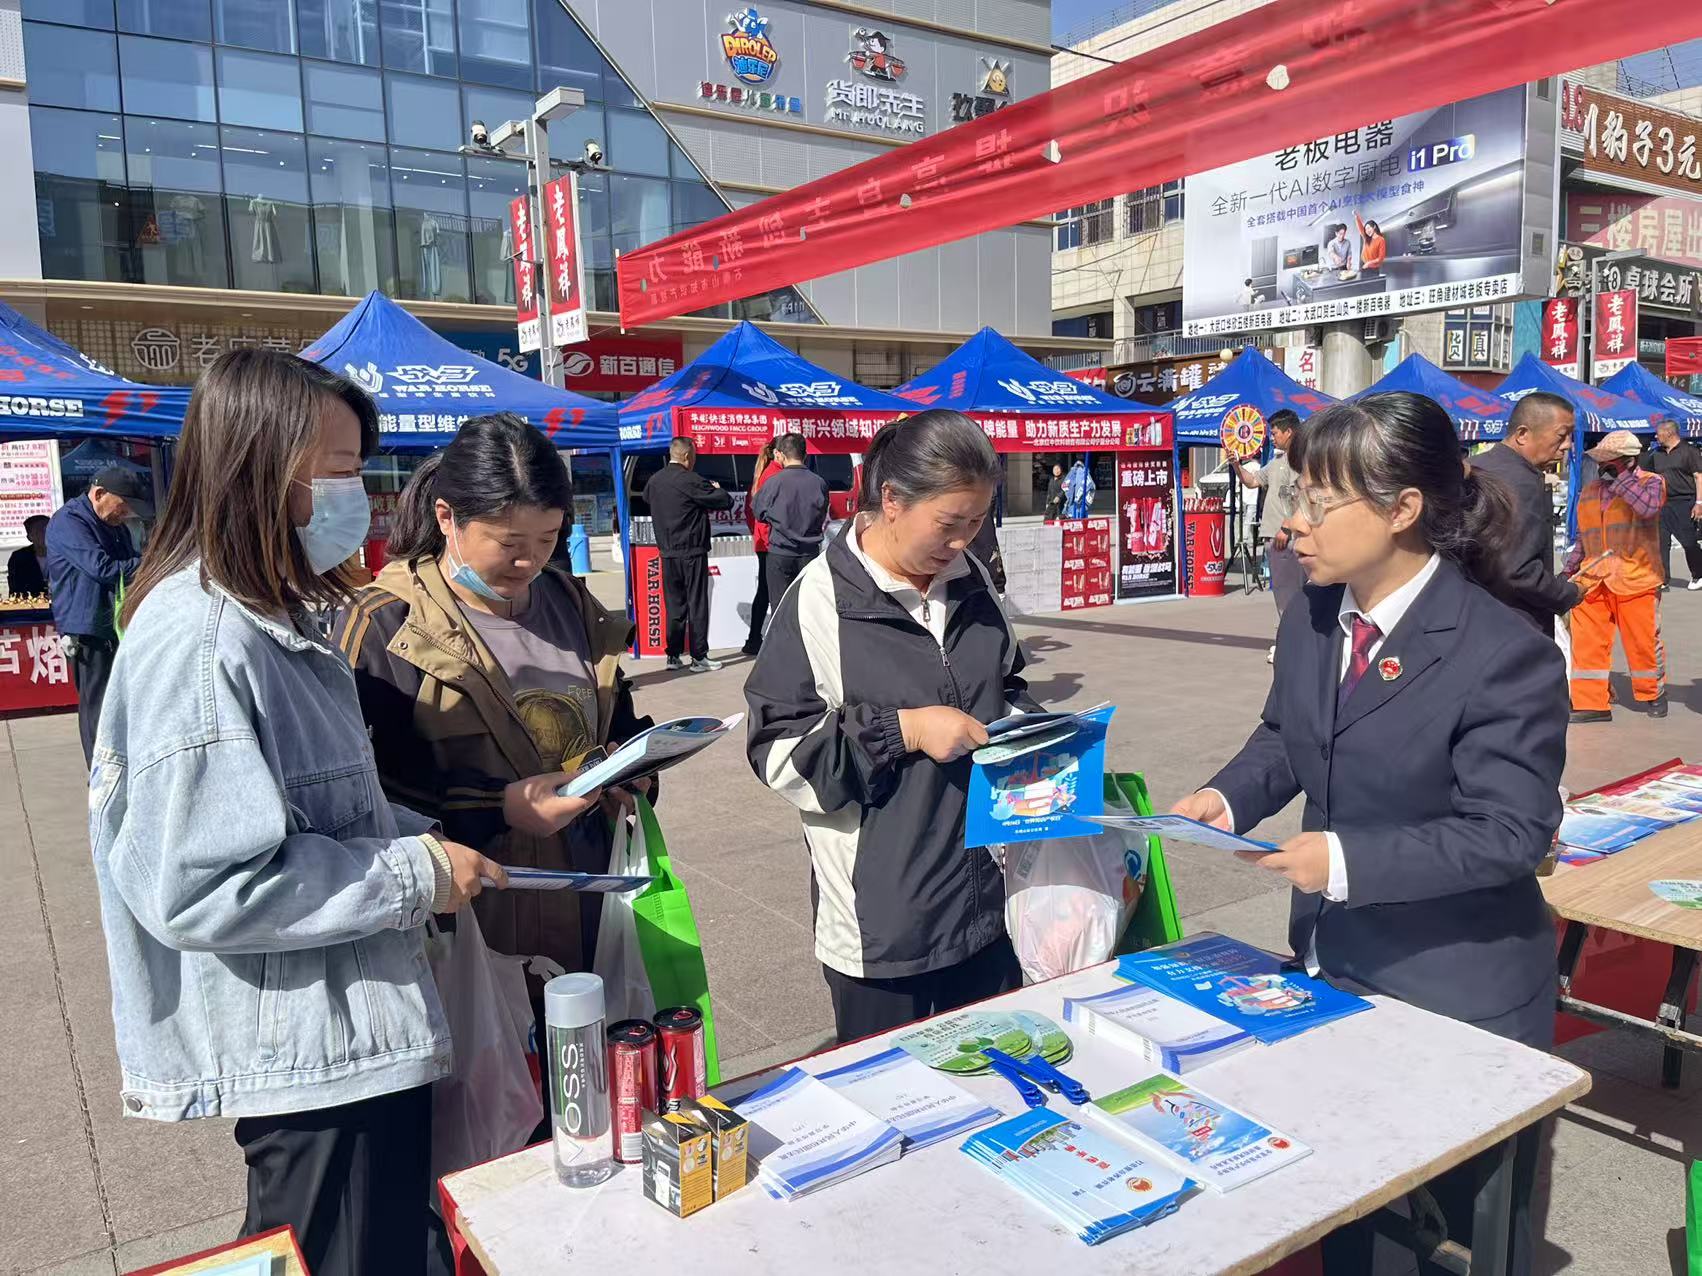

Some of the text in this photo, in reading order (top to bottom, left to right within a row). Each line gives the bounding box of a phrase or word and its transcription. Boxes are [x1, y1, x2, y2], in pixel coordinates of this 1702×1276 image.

[832, 80, 924, 118] 货郎先生
[1274, 119, 1394, 170] 老板电器
[1432, 141, 1474, 167] Pro
[1211, 154, 1401, 217] 全新一代AI数字厨电
[600, 355, 675, 377] 新百通信
[772, 416, 893, 440] 加强新兴领域知识
[1025, 419, 1122, 438] 助力新质生产力发展
[1121, 469, 1168, 487] 重磅上市
[648, 556, 661, 648] WAR HORSE
